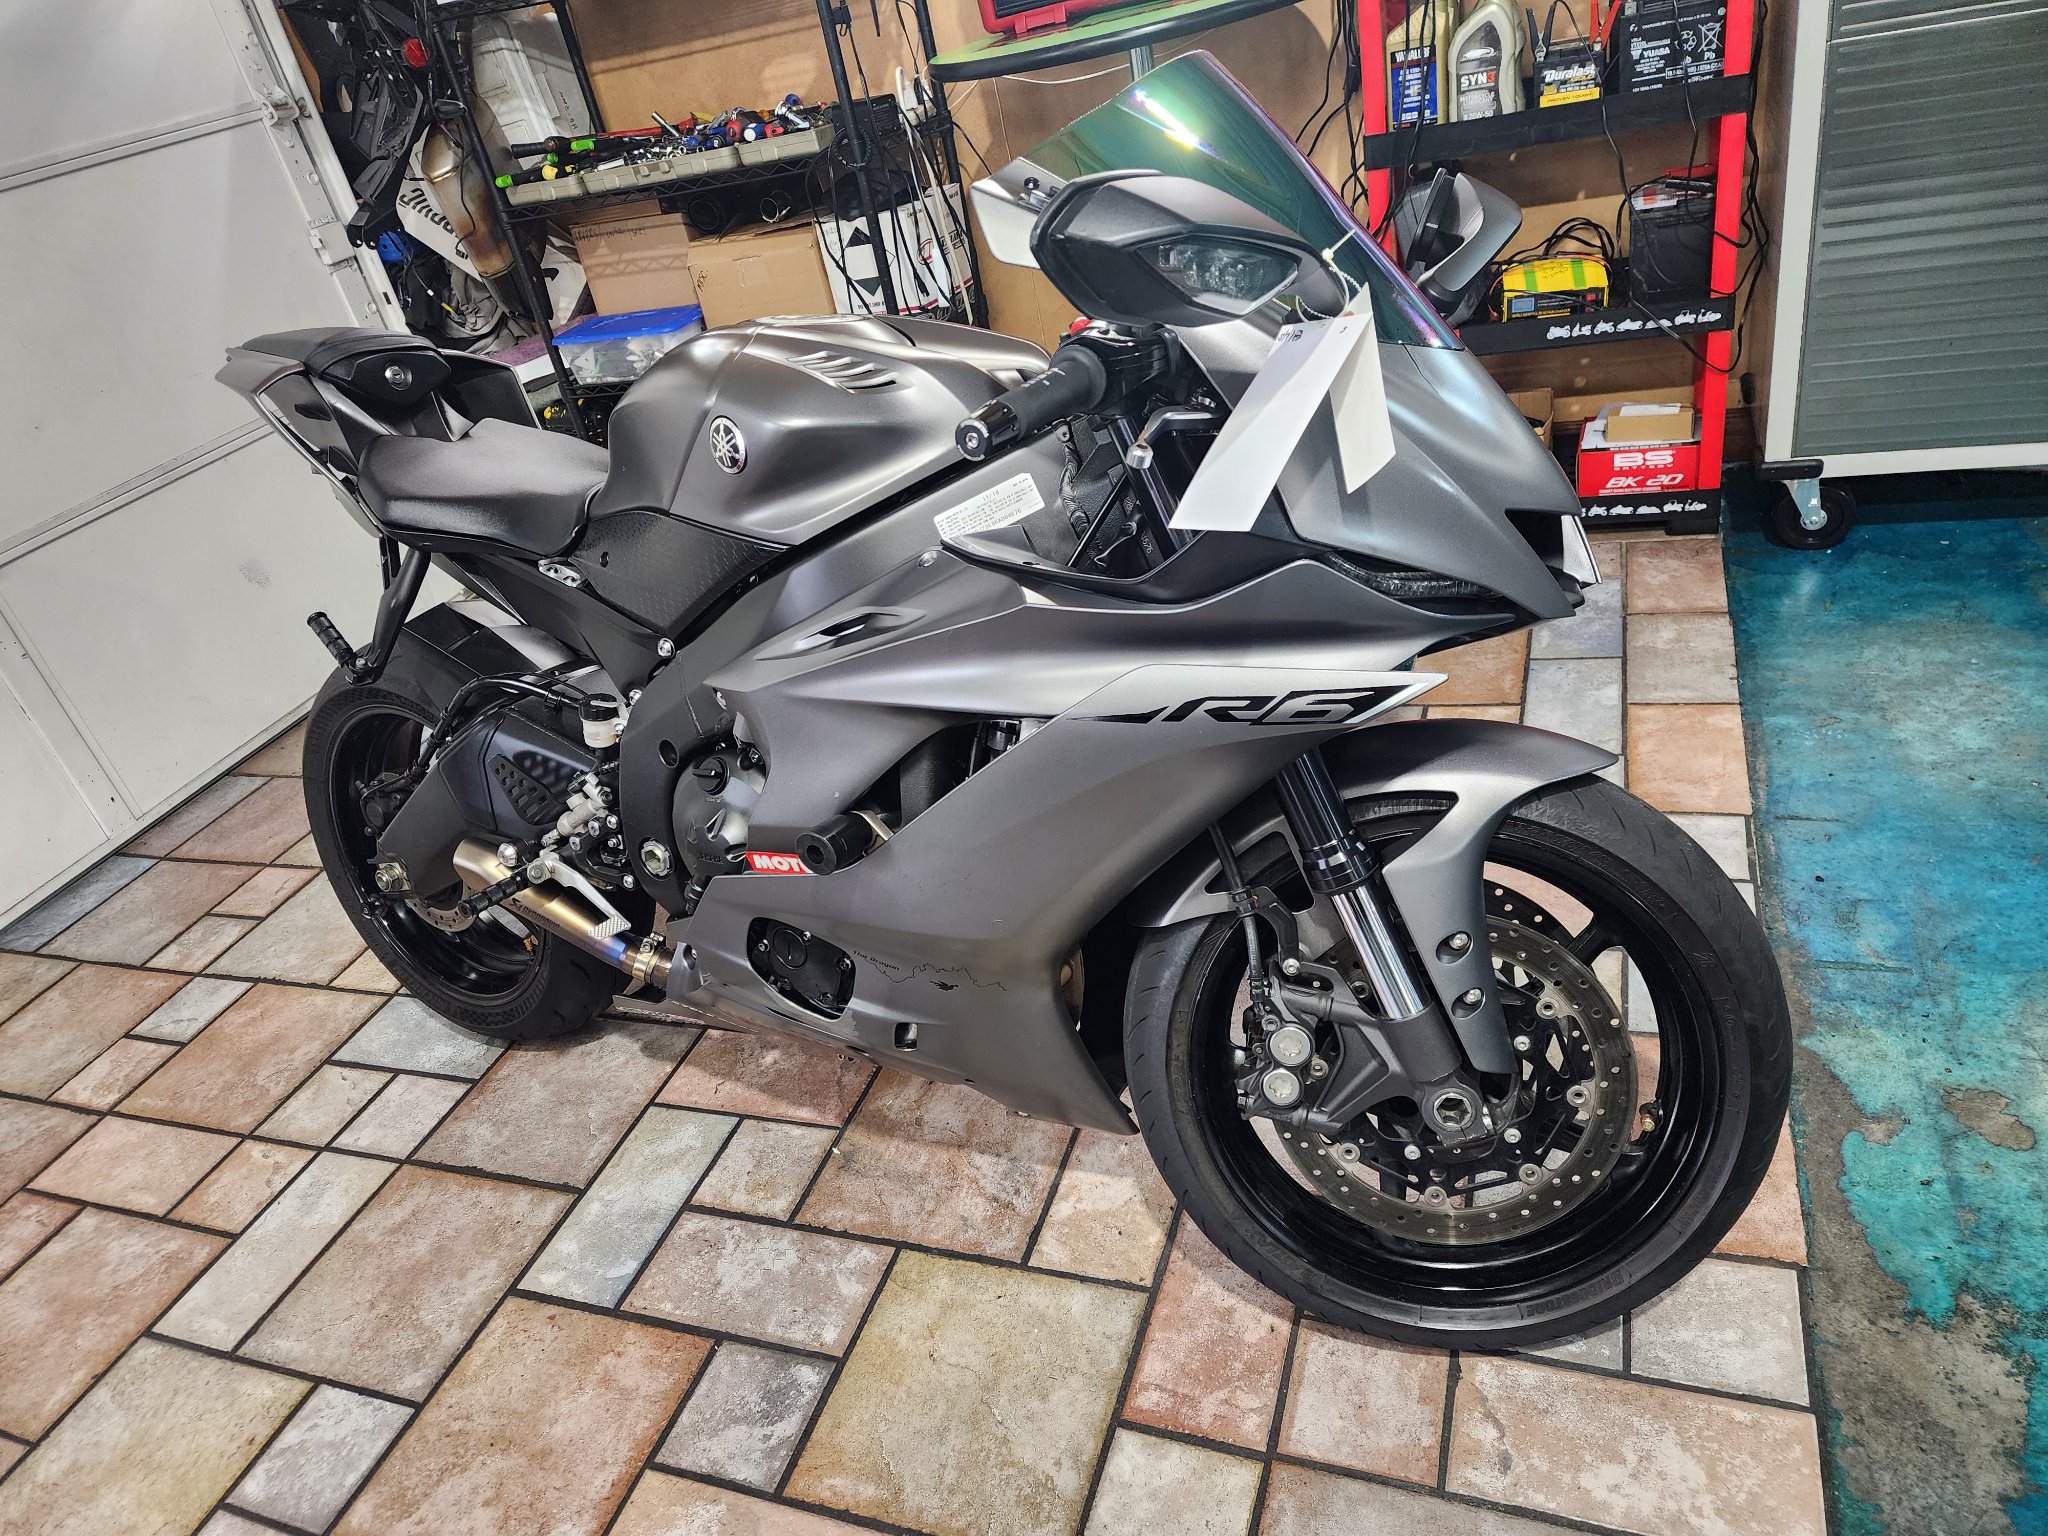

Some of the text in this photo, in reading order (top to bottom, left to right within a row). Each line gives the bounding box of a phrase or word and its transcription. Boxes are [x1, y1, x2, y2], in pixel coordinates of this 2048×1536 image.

[1643, 47, 1670, 58] YUASA
[1704, 51, 1716, 60] Pb
[1543, 63, 1597, 83] Duralast
[1613, 449, 1674, 468] BS
[1605, 473, 1684, 488] BK 20
[1160, 683, 1418, 727] R6
[752, 854, 814, 873] MOT
